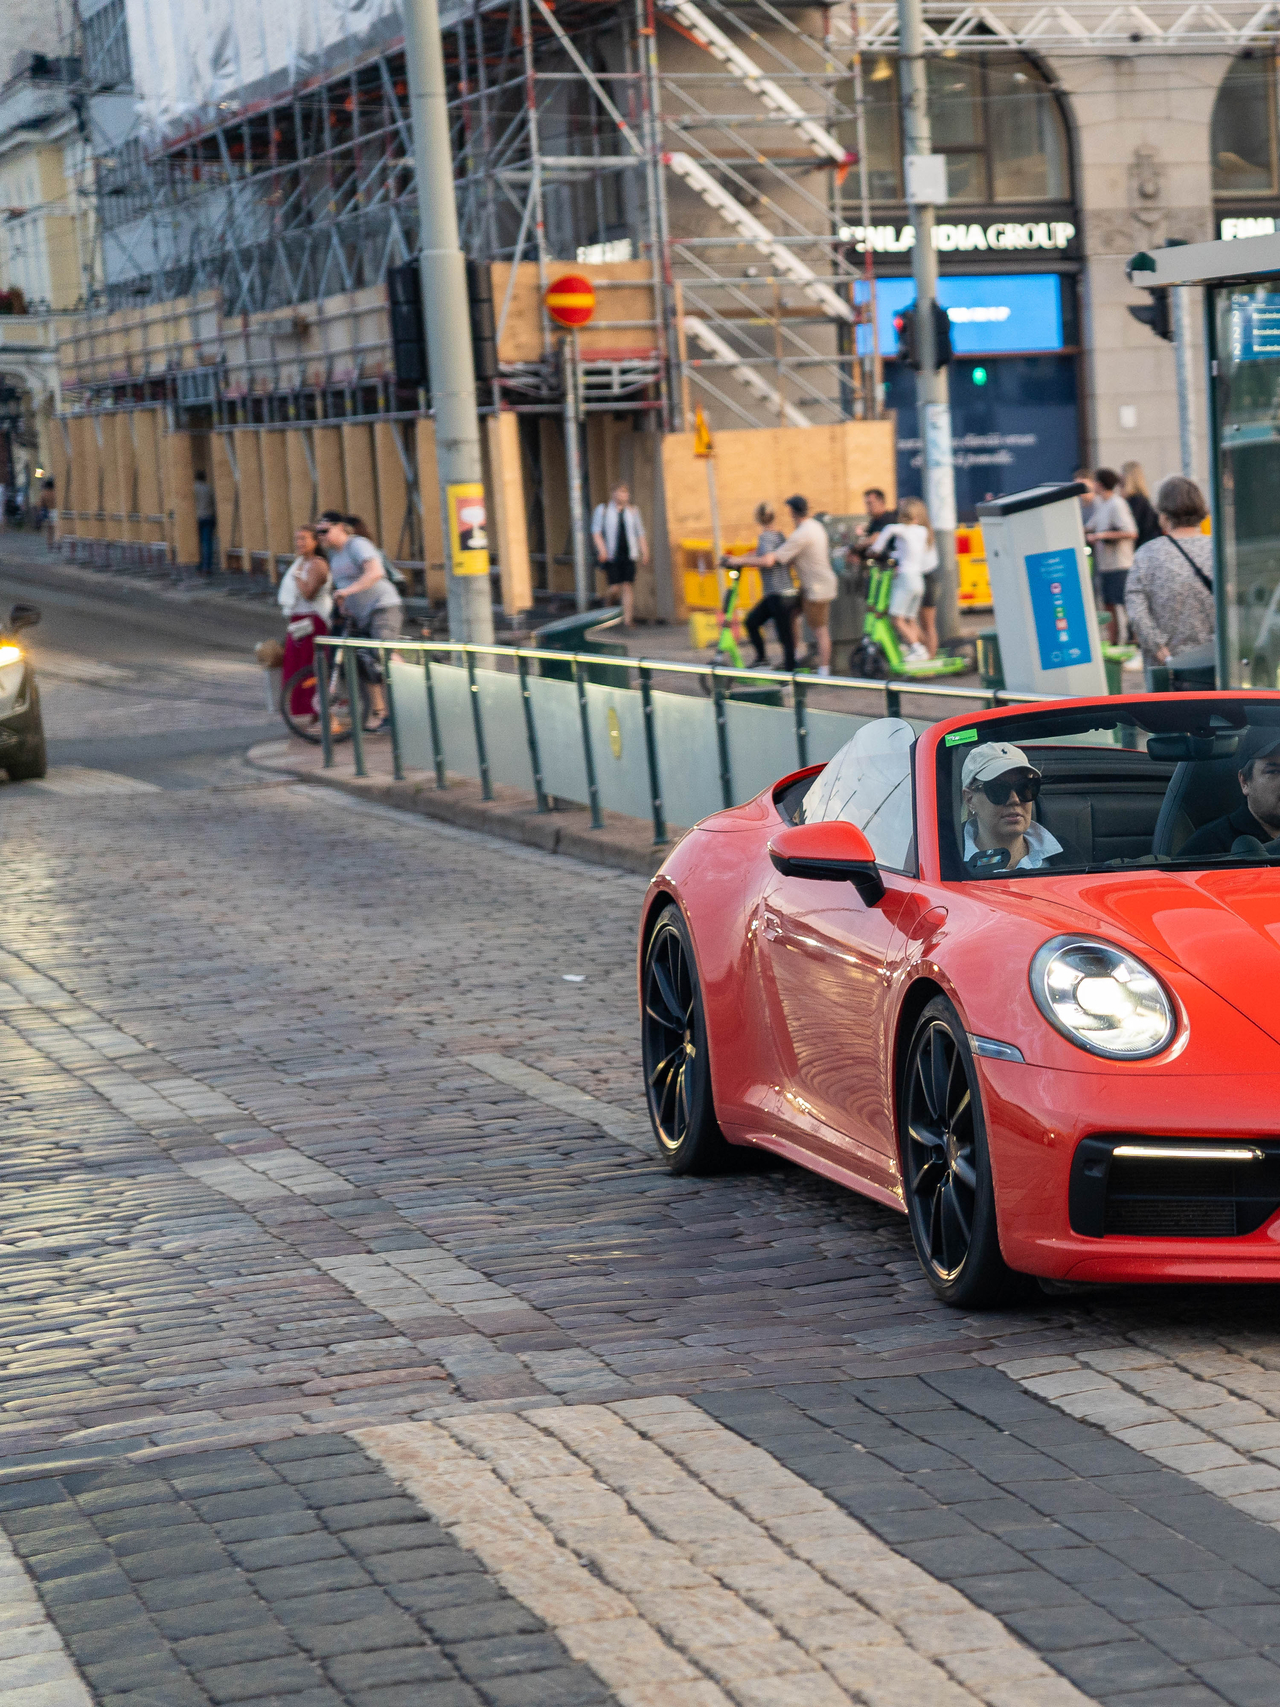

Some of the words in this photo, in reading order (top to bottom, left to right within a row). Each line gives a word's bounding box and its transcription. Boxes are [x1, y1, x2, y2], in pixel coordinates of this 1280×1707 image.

[839, 224, 988, 252] INLADIA
[986, 222, 1076, 249] GROUP
[1233, 311, 1240, 322] 2
[1233, 327, 1240, 338] 2
[1233, 343, 1240, 354] 2
